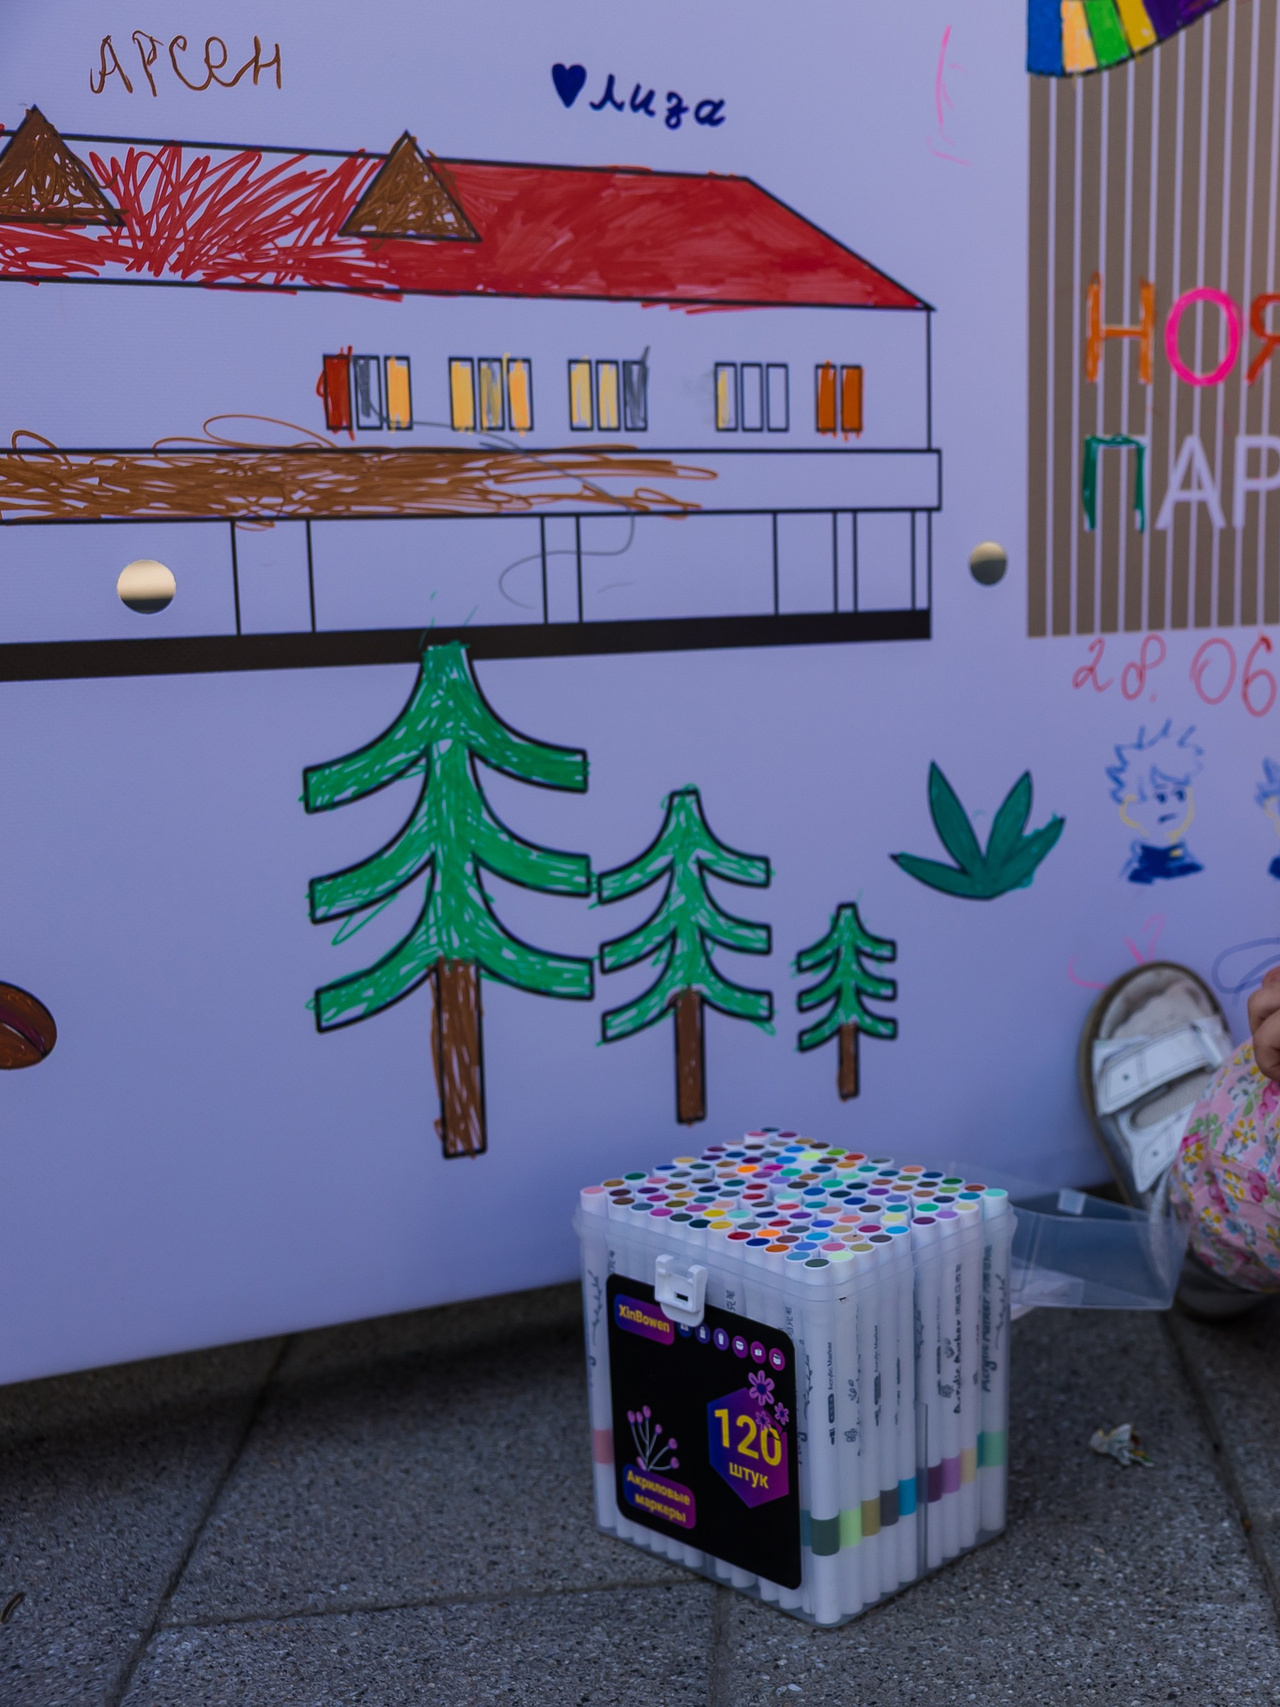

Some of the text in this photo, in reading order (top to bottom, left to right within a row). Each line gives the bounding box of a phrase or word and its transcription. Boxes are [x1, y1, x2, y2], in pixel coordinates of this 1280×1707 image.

[618, 1304, 670, 1333] XinBowen
[714, 1408, 782, 1466] 120
[627, 1470, 691, 1506] Акриловые
[729, 1461, 770, 1490] штук
[634, 1493, 687, 1522] маркеры
